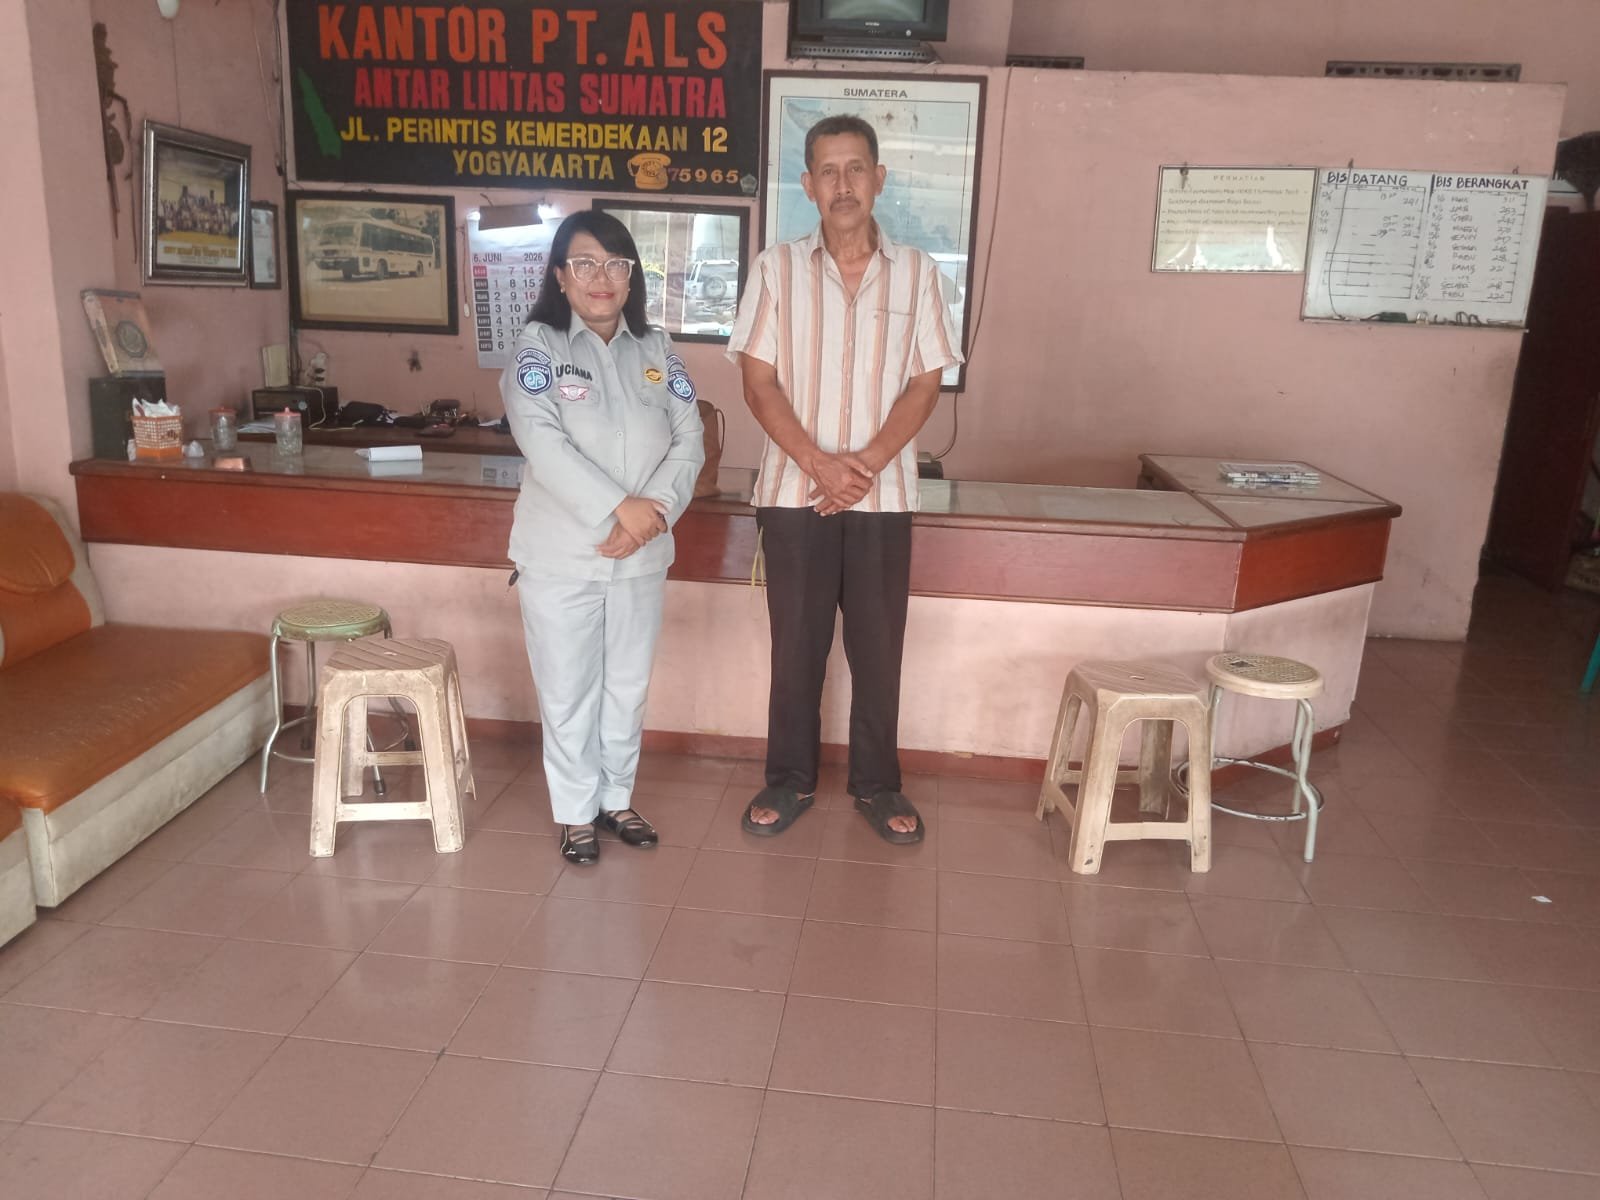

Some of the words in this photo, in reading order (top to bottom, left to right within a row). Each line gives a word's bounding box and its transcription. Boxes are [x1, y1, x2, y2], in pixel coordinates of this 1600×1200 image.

[318, 5, 507, 63] KANTOR
[532, 9, 608, 65] PT.
[624, 11, 727, 70] ALS
[354, 67, 450, 110] ANTAR
[463, 69, 566, 113] LINTAS
[580, 73, 726, 118] SUMATRA
[843, 88, 908, 98] SUMATERA
[340, 116, 380, 142] JL.
[387, 117, 497, 145] PERINTIS
[505, 120, 688, 151] KEMERDEKAAN
[702, 127, 728, 153] 12
[452, 149, 615, 181] YOGYAKARTA
[1327, 171, 1347, 184] BIS
[1352, 173, 1408, 187] DATANG
[1435, 175, 1452, 188] BIS
[1456, 177, 1529, 190] BERANGKAT
[482, 252, 502, 263] JUNI
[508, 266, 515, 275] 7
[523, 266, 534, 275] 14
[494, 278, 499, 288] 1
[509, 278, 516, 288] 8
[523, 278, 536, 288] 15
[494, 291, 501, 300] 2
[510, 291, 517, 300] 9
[524, 291, 536, 300] 16
[495, 304, 502, 313] 3
[508, 304, 521, 313] 10
[496, 316, 503, 325] 4
[510, 316, 521, 325] 11
[497, 328, 504, 338] 5
[498, 341, 505, 350] 6
